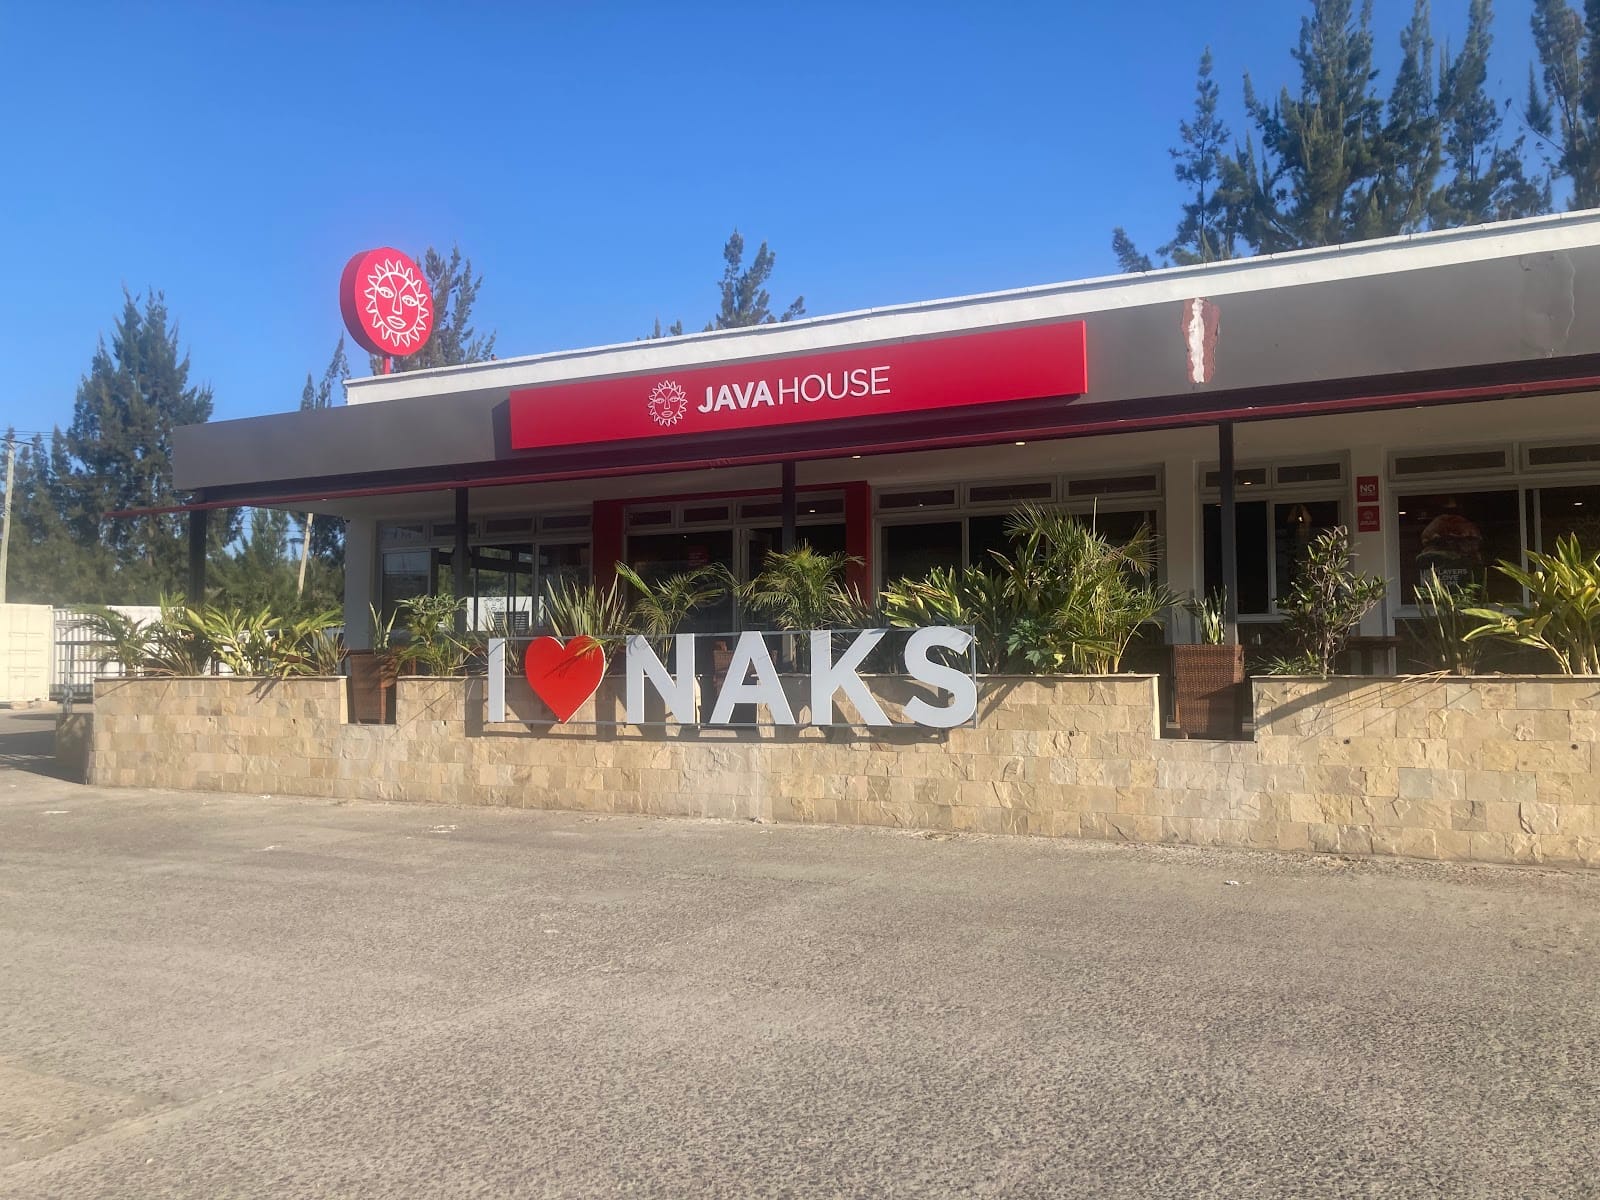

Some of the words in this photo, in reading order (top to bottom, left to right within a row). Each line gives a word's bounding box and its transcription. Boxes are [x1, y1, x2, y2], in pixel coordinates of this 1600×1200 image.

[697, 380, 774, 413] JAVA
[778, 366, 891, 404] HOUSE
[488, 637, 505, 723] I
[625, 626, 977, 727] NAKS
